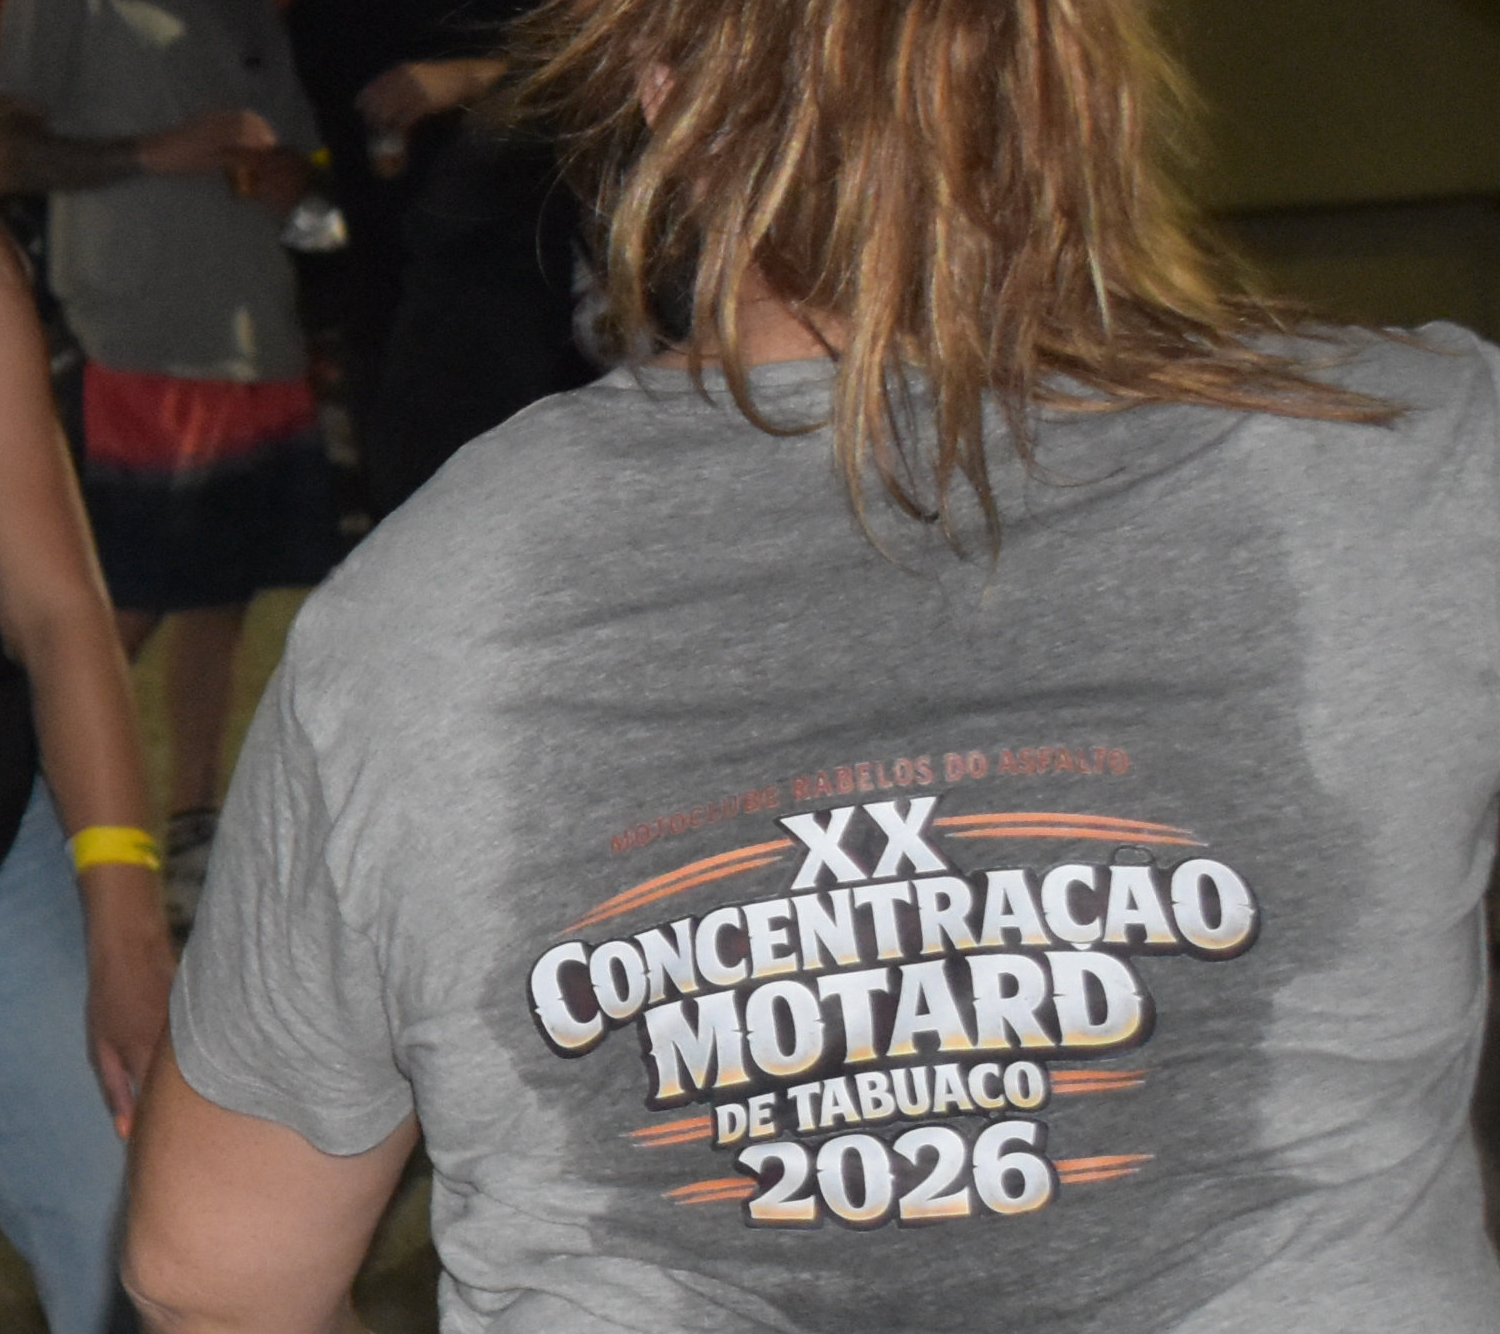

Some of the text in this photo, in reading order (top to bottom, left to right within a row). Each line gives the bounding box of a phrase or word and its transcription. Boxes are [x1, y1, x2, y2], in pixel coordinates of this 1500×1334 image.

[610, 746, 1130, 855] MOTOCLUBE RABELOS DO ASFALTO
[779, 796, 949, 891] XX
[649, 950, 1145, 1100] MOTARD
[715, 1091, 776, 1144] DE
[737, 1119, 1055, 1223] 2026
